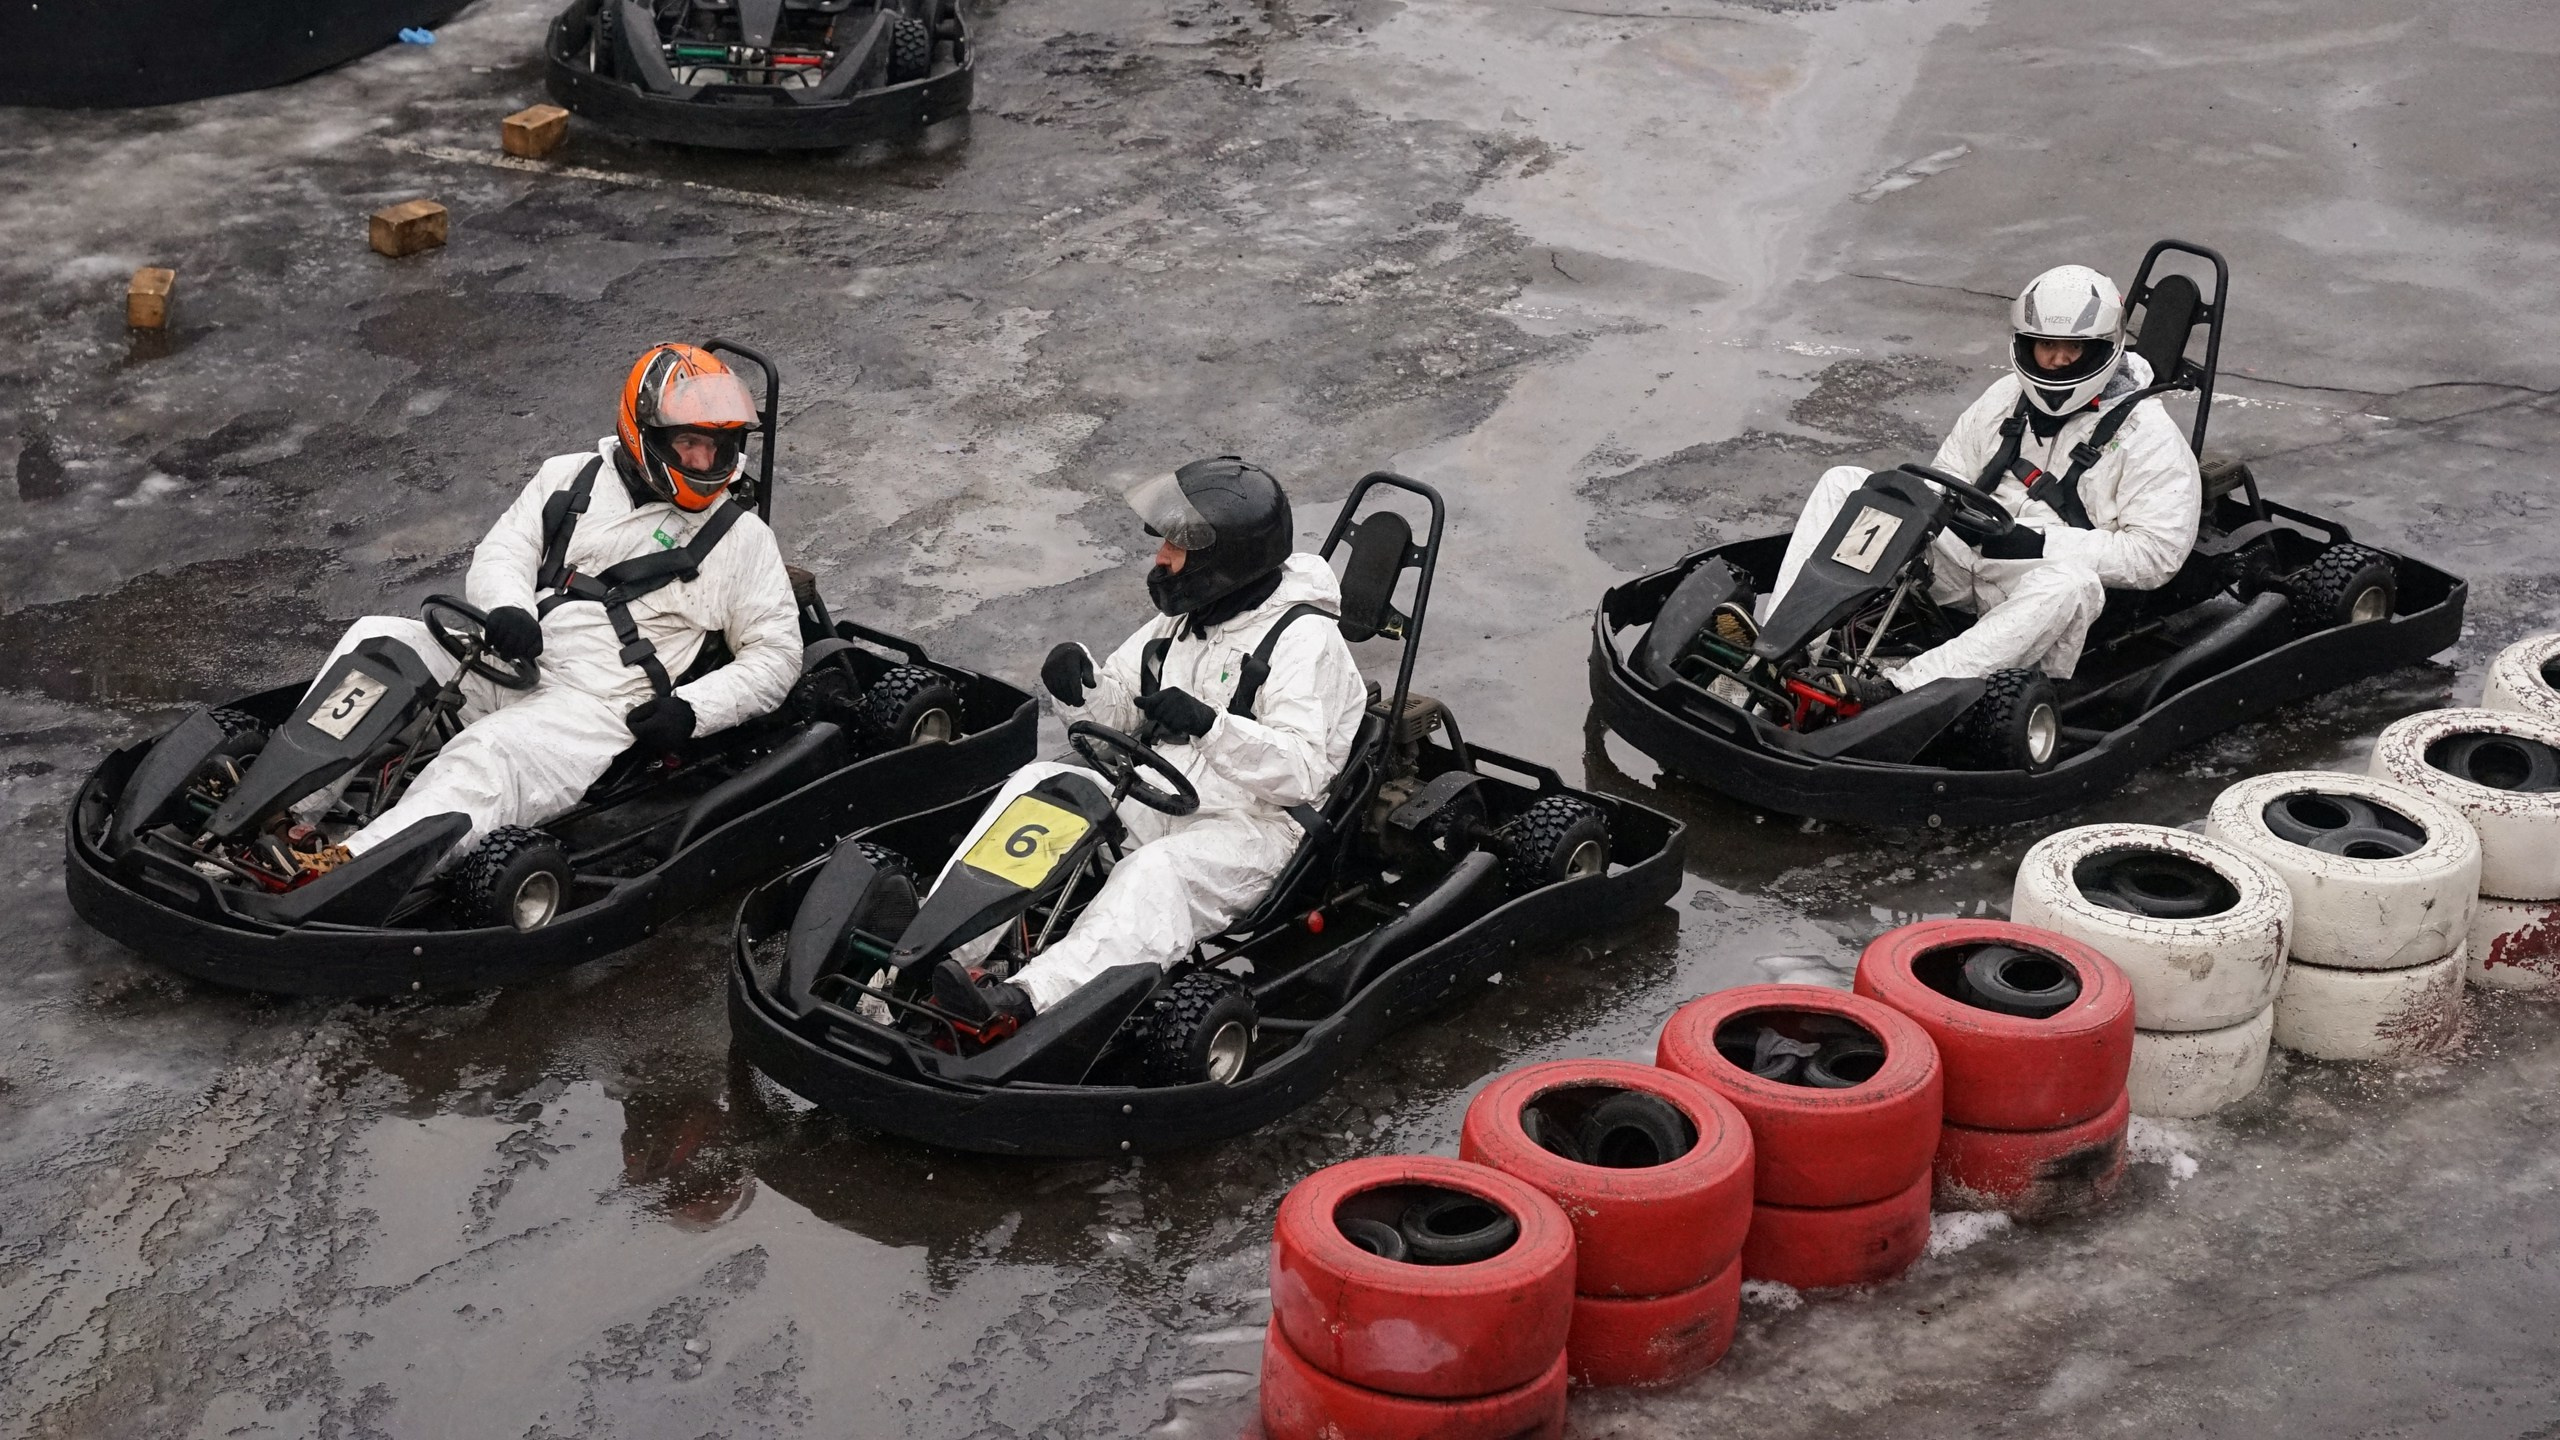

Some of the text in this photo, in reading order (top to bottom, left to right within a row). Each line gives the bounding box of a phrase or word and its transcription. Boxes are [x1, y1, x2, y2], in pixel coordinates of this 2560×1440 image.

[2044, 315, 2073, 325] HIZER
[1858, 524, 1881, 556] 1
[332, 687, 366, 720] 5
[1005, 824, 1050, 858] 6
